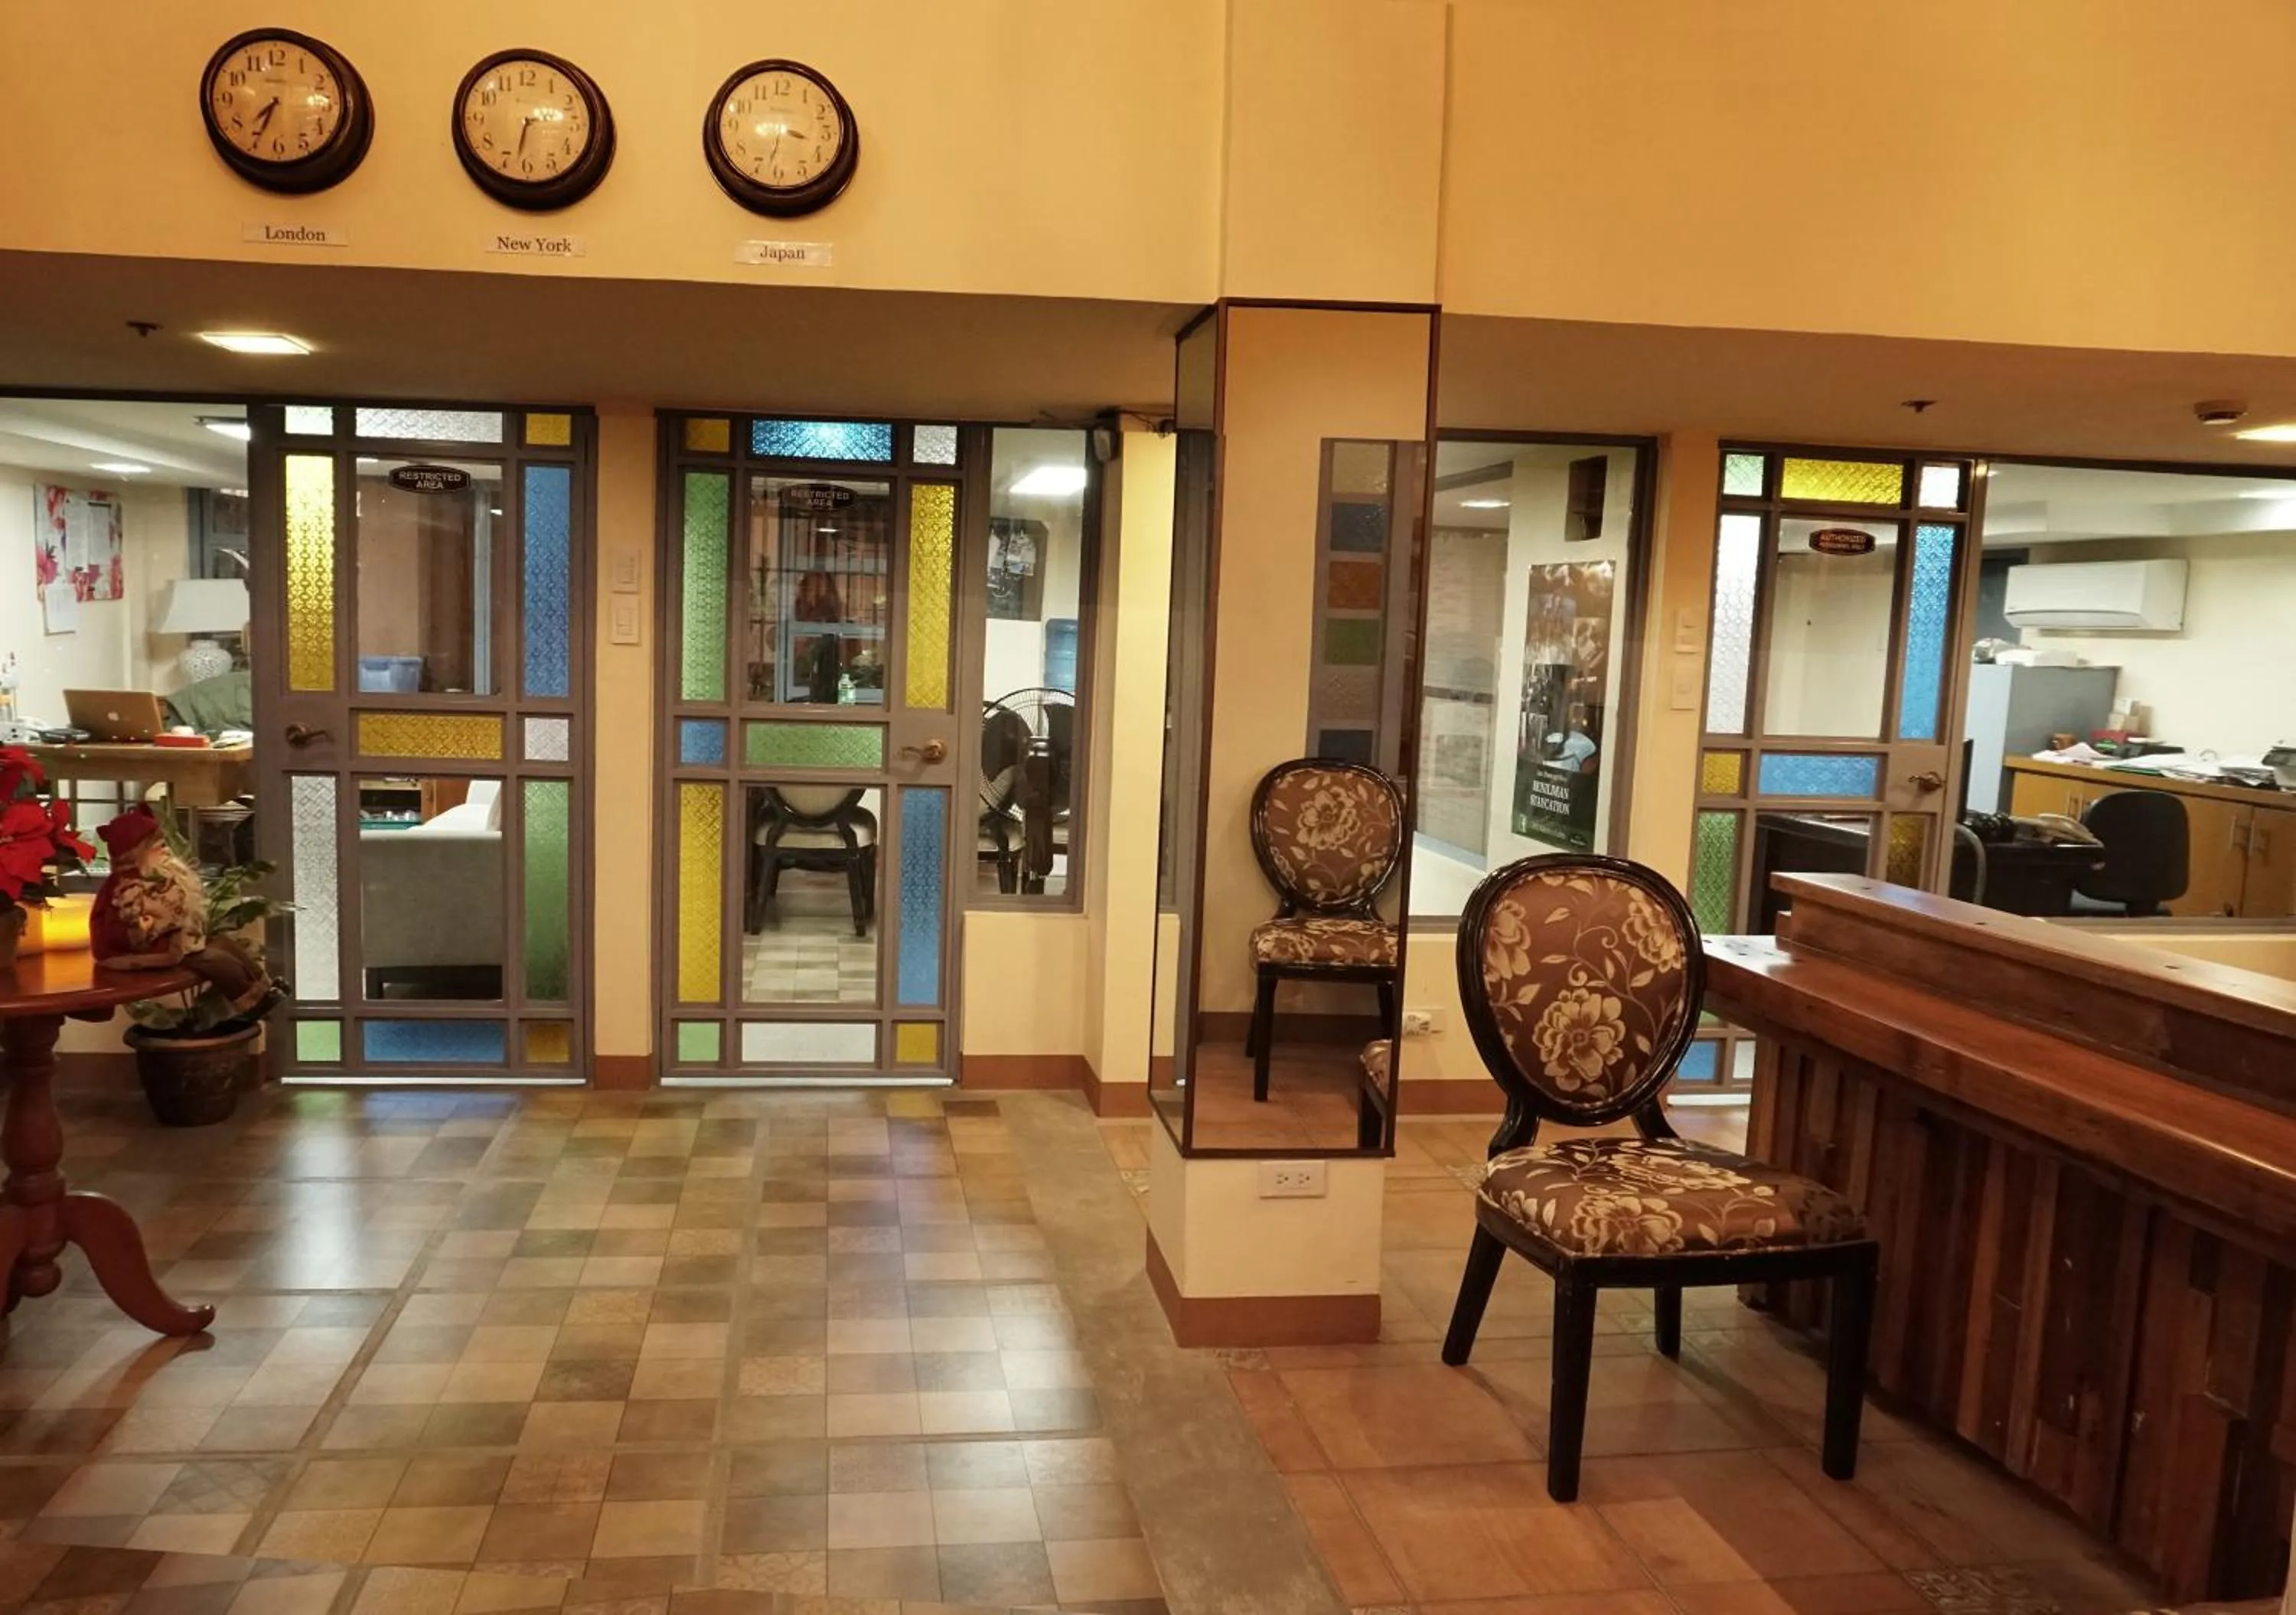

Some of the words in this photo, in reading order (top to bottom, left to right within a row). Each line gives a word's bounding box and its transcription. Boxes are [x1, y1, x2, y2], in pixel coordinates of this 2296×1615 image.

[246, 55, 261, 72] 11
[269, 49, 285, 66] 12
[230, 71, 246, 86] 10
[315, 73, 325, 90] 2
[498, 75, 511, 92] 11
[520, 70, 536, 86] 12
[754, 85, 767, 100] 11
[773, 80, 791, 96] 12
[222, 92, 233, 105] 9
[481, 91, 497, 106] 10
[563, 94, 573, 111] 2
[736, 100, 752, 114] 10
[816, 104, 825, 120] 2
[473, 112, 484, 126] 9
[728, 118, 739, 133] 9
[272, 136, 285, 154] 6
[298, 133, 309, 149] 5
[562, 137, 571, 155] 4
[502, 151, 511, 168] 7
[521, 158, 533, 174] 6
[546, 152, 556, 170] 5
[754, 157, 764, 174] 7
[797, 160, 807, 175] 5
[773, 165, 784, 180] 6
[265, 225, 326, 242] London
[497, 236, 531, 250] New
[536, 238, 572, 253] York
[760, 244, 805, 263] Japan
[399, 471, 461, 481] RESTRICTED
[416, 481, 444, 489] AREA
[791, 488, 850, 501] RESTRICTED
[806, 498, 833, 507] AREA
